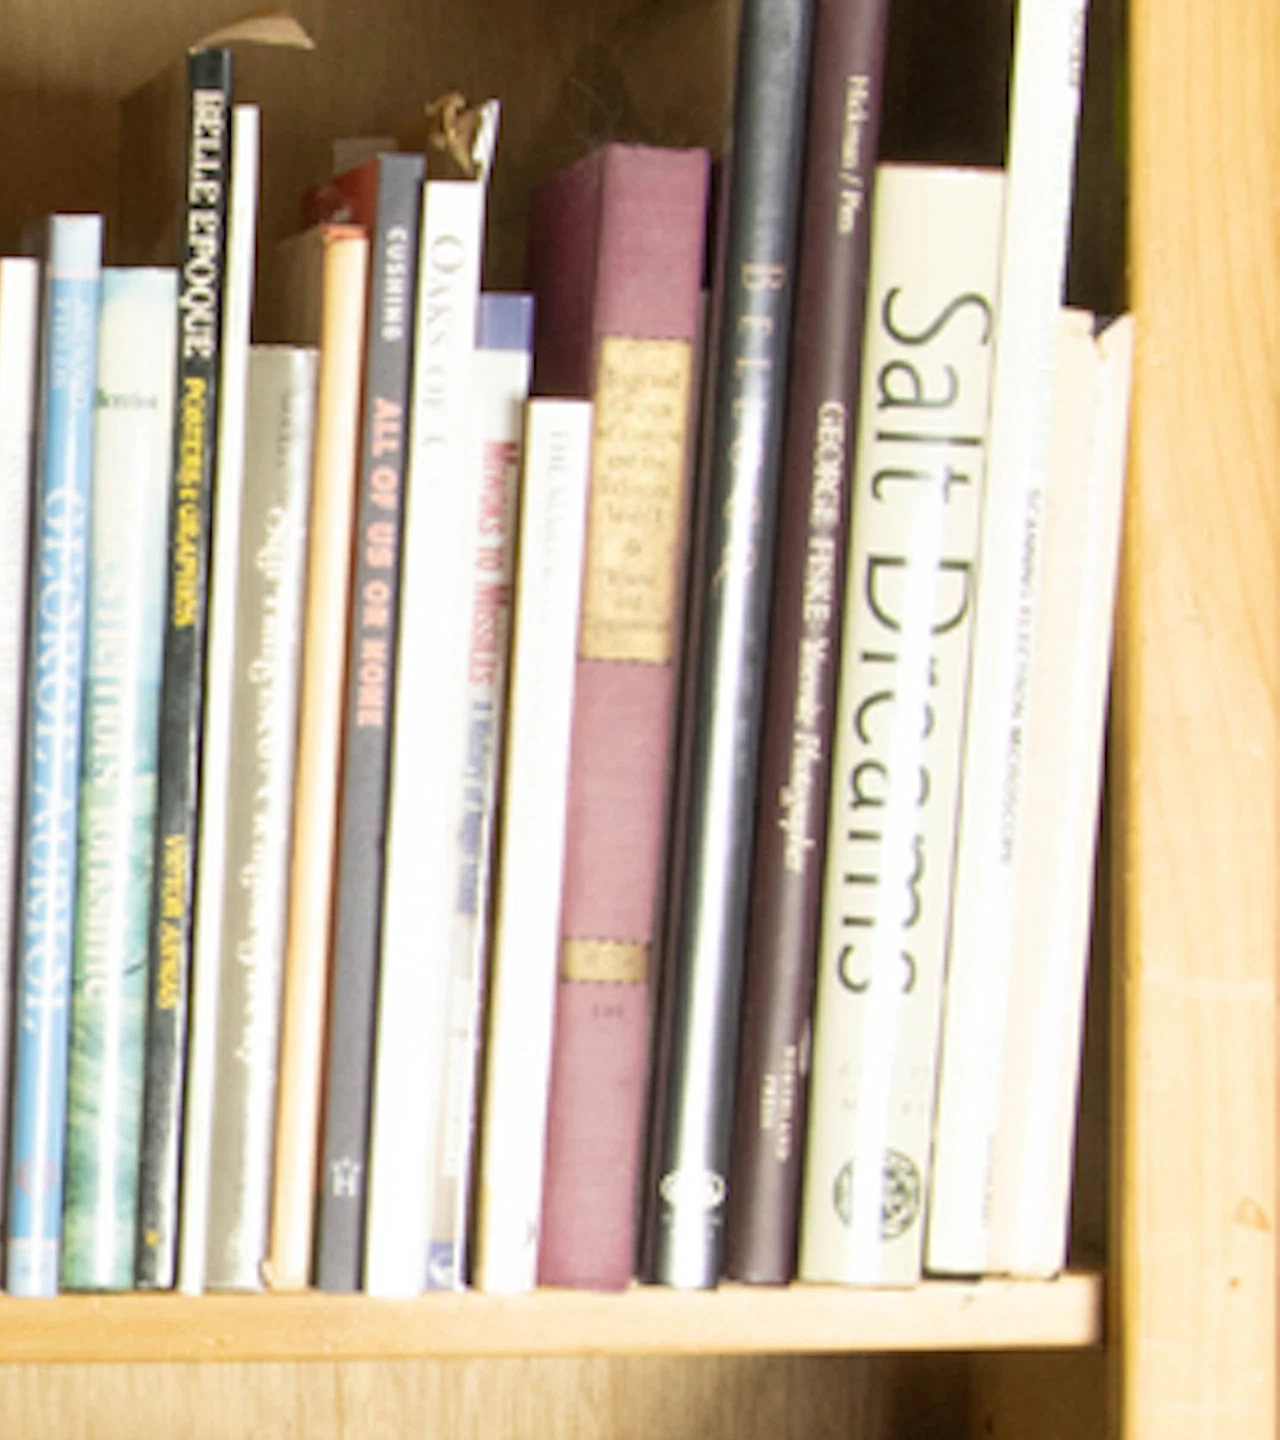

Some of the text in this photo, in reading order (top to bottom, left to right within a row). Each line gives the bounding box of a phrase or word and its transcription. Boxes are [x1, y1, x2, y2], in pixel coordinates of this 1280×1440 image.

[357, 227, 408, 727] CUSHING ALL OF US OR NONE
[833, 286, 994, 997] Salt Dreams
